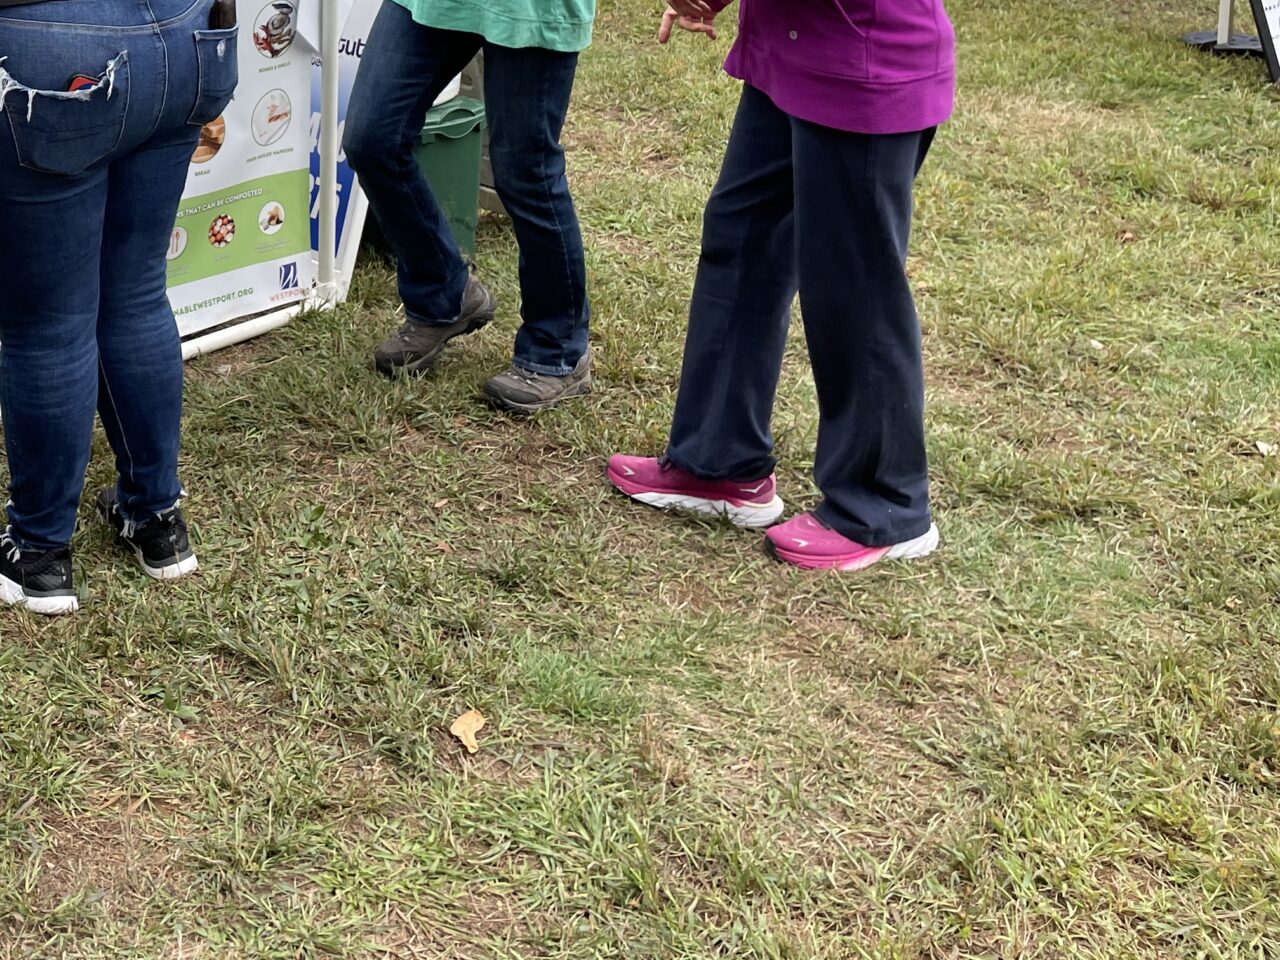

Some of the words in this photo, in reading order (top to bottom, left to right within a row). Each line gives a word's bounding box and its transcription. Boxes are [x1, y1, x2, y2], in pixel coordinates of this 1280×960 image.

[185, 206, 201, 216] THAT
[202, 202, 216, 212] CAN
[225, 188, 263, 203] COMPOSTED
[173, 287, 254, 316] NABLEWESTPORT.ORG
